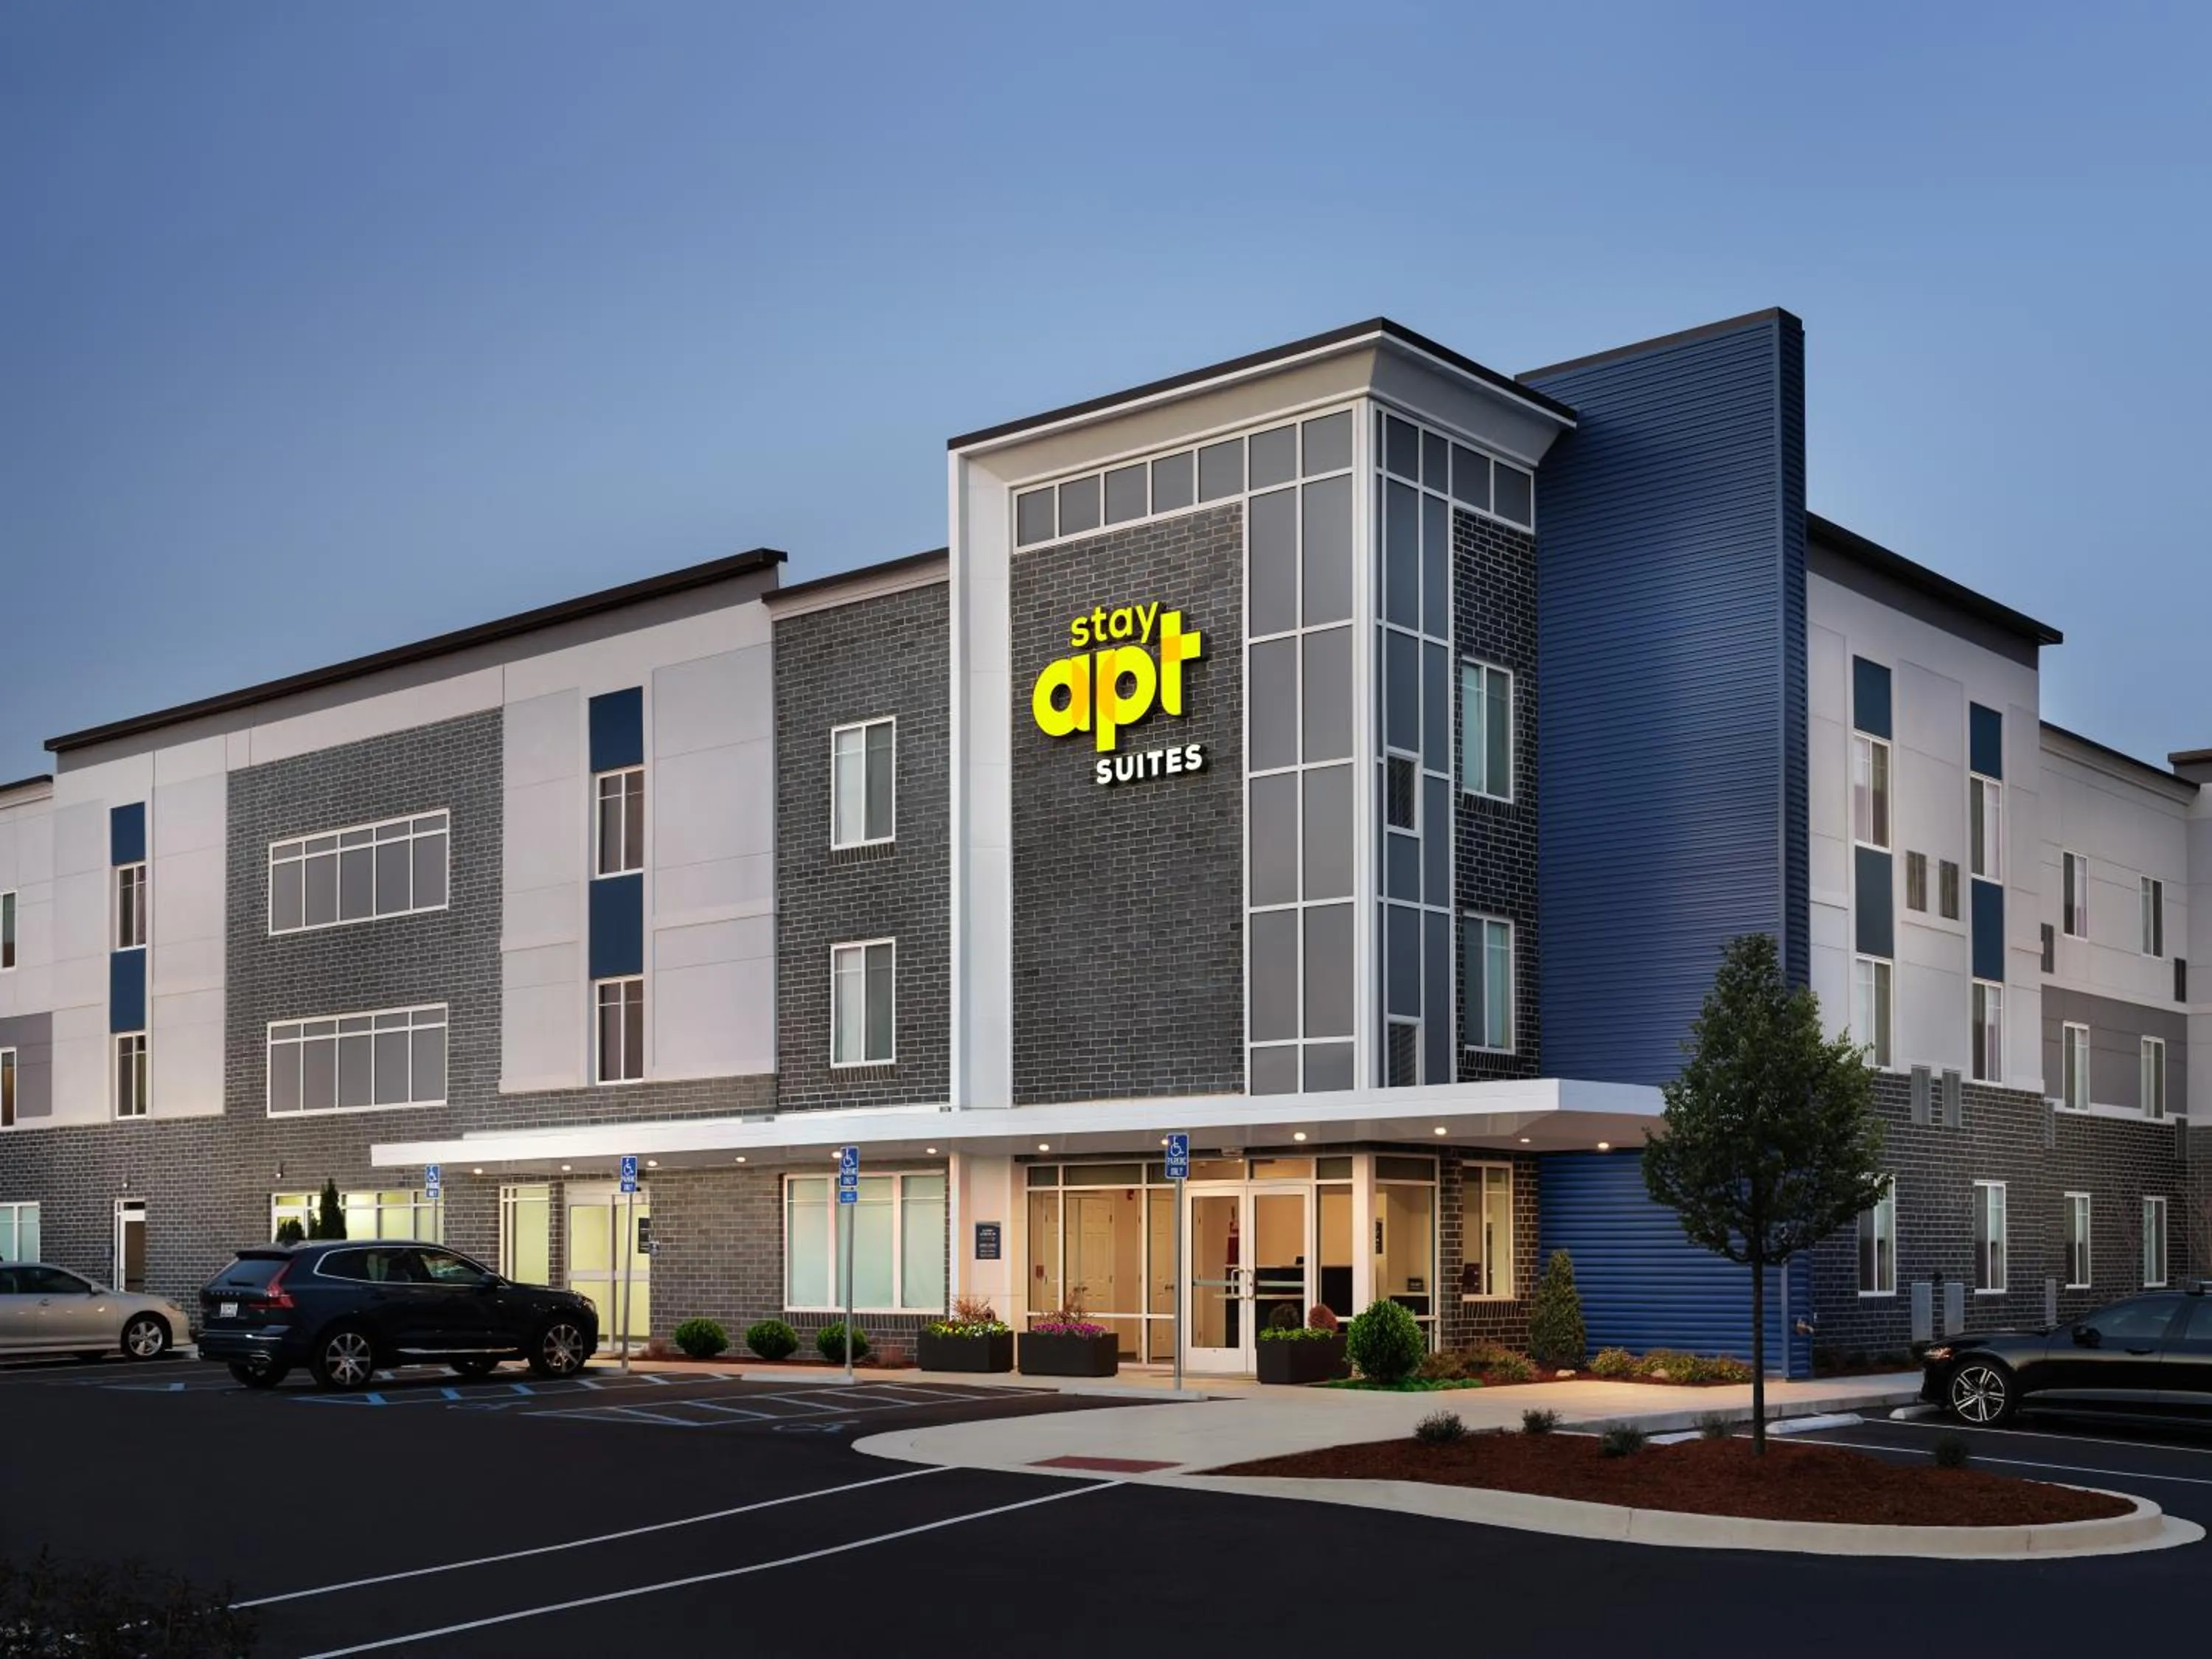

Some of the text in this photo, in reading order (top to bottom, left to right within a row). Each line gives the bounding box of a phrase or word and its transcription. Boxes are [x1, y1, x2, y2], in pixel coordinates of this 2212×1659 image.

[1071, 601, 1158, 647] stay
[1032, 611, 1201, 753] apt
[1096, 744, 1203, 785] SUITES
